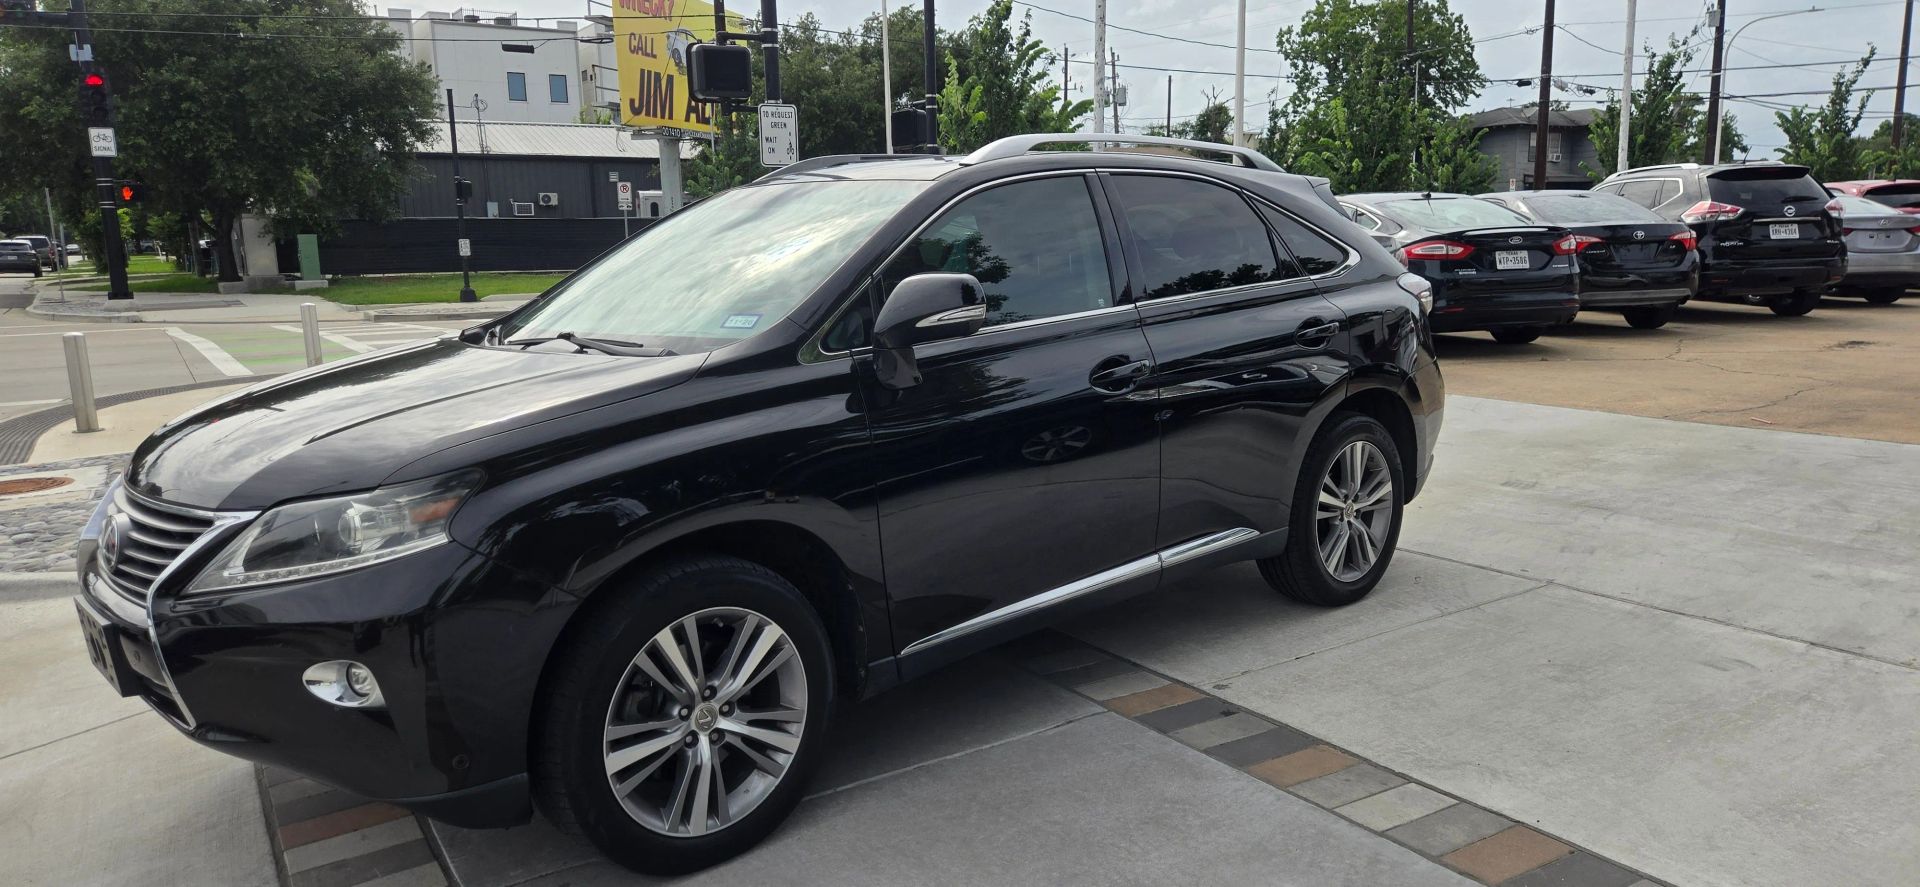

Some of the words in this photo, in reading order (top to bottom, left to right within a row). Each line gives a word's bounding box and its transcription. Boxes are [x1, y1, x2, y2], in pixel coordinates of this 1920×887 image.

[628, 32, 657, 59] CALL
[629, 68, 674, 121] JIM
[771, 111, 793, 119] REQUEST
[765, 136, 777, 144] WAIT
